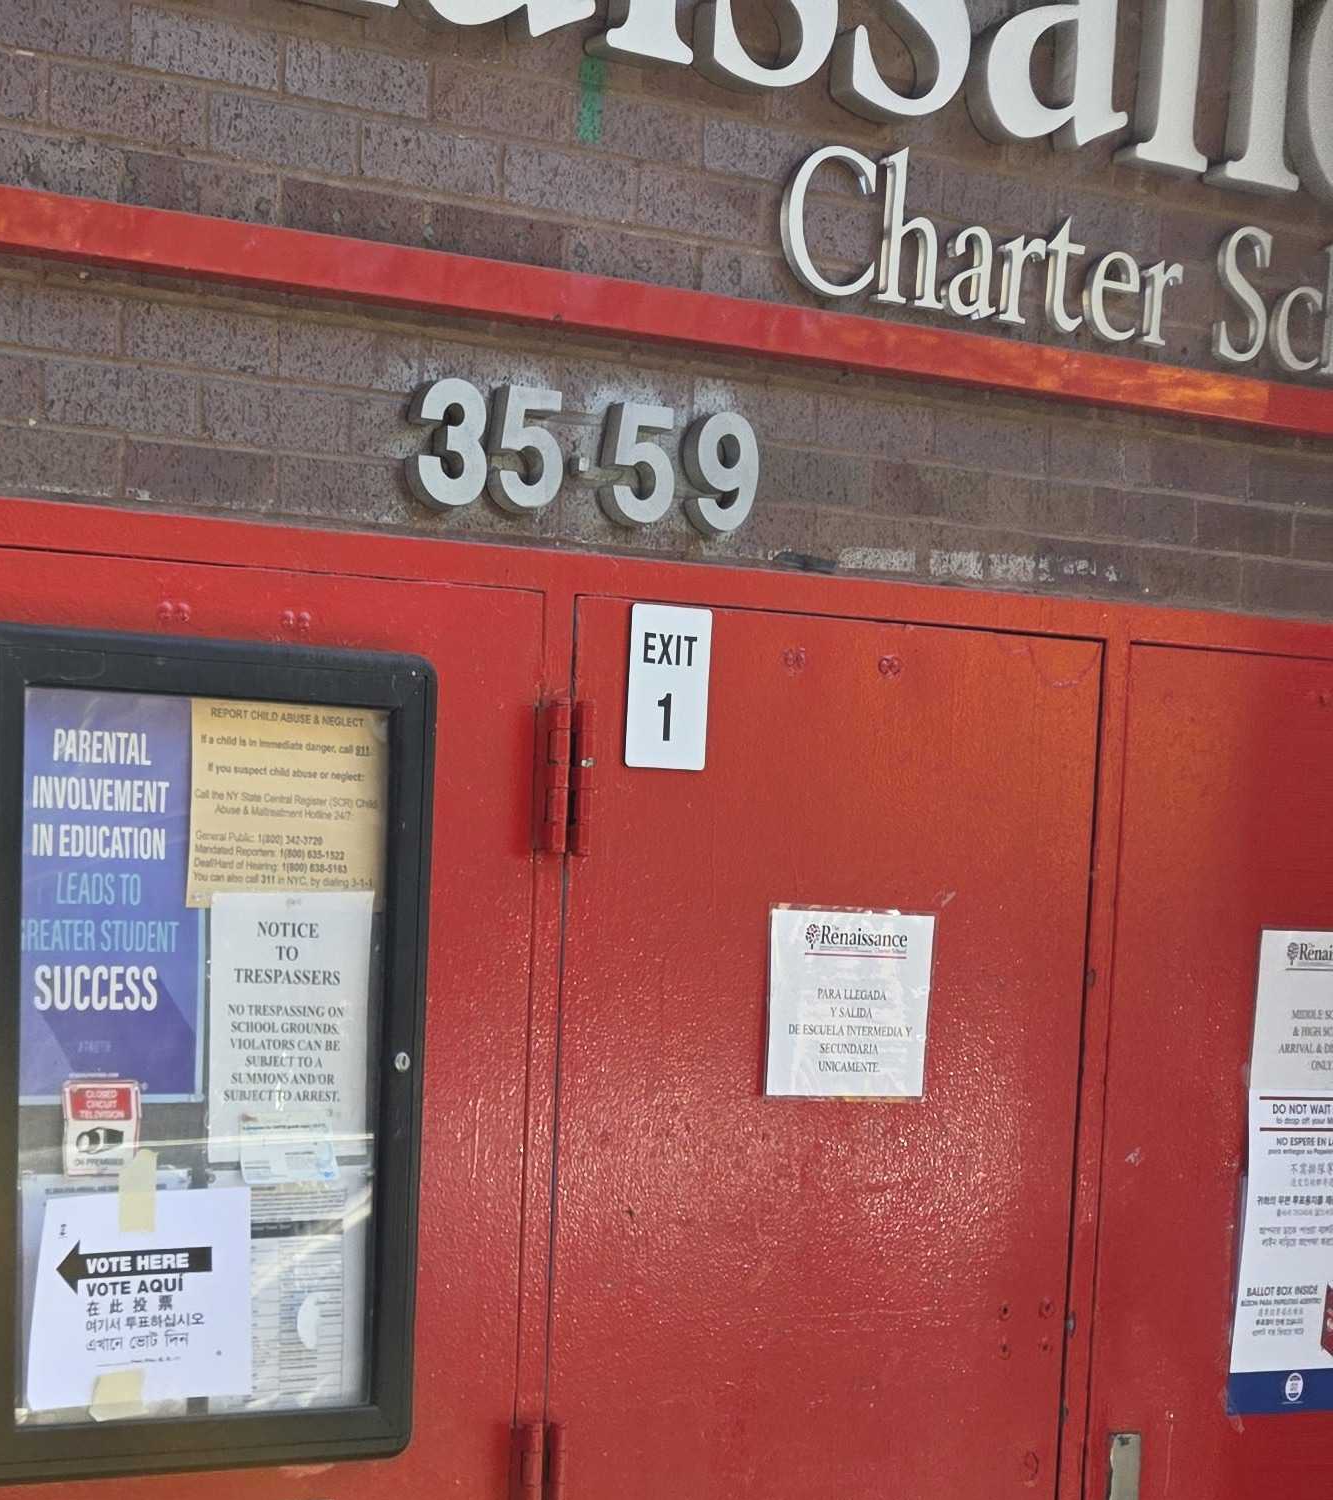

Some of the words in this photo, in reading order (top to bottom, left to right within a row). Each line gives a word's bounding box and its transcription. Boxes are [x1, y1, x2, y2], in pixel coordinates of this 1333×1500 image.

[780, 144, 1183, 348] Charter
[643, 632, 698, 666] EXIT
[210, 707, 248, 719] REPORT
[250, 711, 278, 721] CHILD
[280, 713, 311, 725] ABUSE
[322, 716, 364, 727] NEGLECT
[658, 693, 672, 741] 1
[53, 728, 152, 766] PARENTAL
[216, 736, 237, 745] child
[234, 766, 267, 776] suspect
[33, 776, 169, 814] INVOLVEMENT
[32, 824, 53, 857] IN
[58, 824, 166, 860] EDUCATION
[260, 874, 275, 884] 311
[56, 872, 115, 905] LEADS
[120, 875, 141, 906] TO
[100, 921, 179, 953] STUDENT
[257, 922, 319, 939] NOTICE
[821, 925, 907, 947] Renaissance
[275, 946, 299, 961] TO
[234, 968, 341, 986] TRESPASSERS
[33, 964, 158, 1011] SUCCESS
[817, 988, 841, 1000] PARA
[844, 989, 887, 1001] LLEGADA
[228, 1004, 245, 1016] NO
[248, 1005, 325, 1018] TRESPASSING
[328, 1006, 344, 1018] ON
[831, 1007, 837, 1018] Y
[839, 1007, 873, 1019] SALIDA
[231, 1022, 279, 1034] SCHOOL
[788, 1024, 800, 1035] DE
[803, 1024, 844, 1036] ESCUELA
[847, 1025, 903, 1037] INTERMEDIA
[905, 1026, 913, 1038] Y
[230, 1038, 295, 1051] VIOLATORS
[297, 1039, 322, 1052] CAN
[325, 1040, 341, 1052] BE
[819, 1043, 879, 1054] SECUNDARIA
[1278, 1044, 1314, 1054] ARRIVAL
[245, 1055, 294, 1067] SUBJECT
[297, 1056, 314, 1068] TO
[315, 1056, 323, 1067] A
[231, 1072, 289, 1085] SUMMONS
[224, 1089, 273, 1102] SUBJECT
[1273, 1104, 1286, 1114] DO
[1289, 1104, 1307, 1114] NOT
[1310, 1104, 1331, 1114] WAIT
[1276, 1137, 1288, 1146] NO
[86, 1257, 132, 1275] VOTE
[136, 1253, 189, 1271] HERE
[86, 1281, 131, 1297] VOTE
[137, 1273, 183, 1294] AQUÍ
[1247, 1287, 1274, 1296] BALLOT
[1277, 1286, 1292, 1296] BOX
[86, 1295, 173, 1317] 在此投票
[86, 1318, 121, 1333] 여기서
[126, 1312, 205, 1328] 투표하십시오
